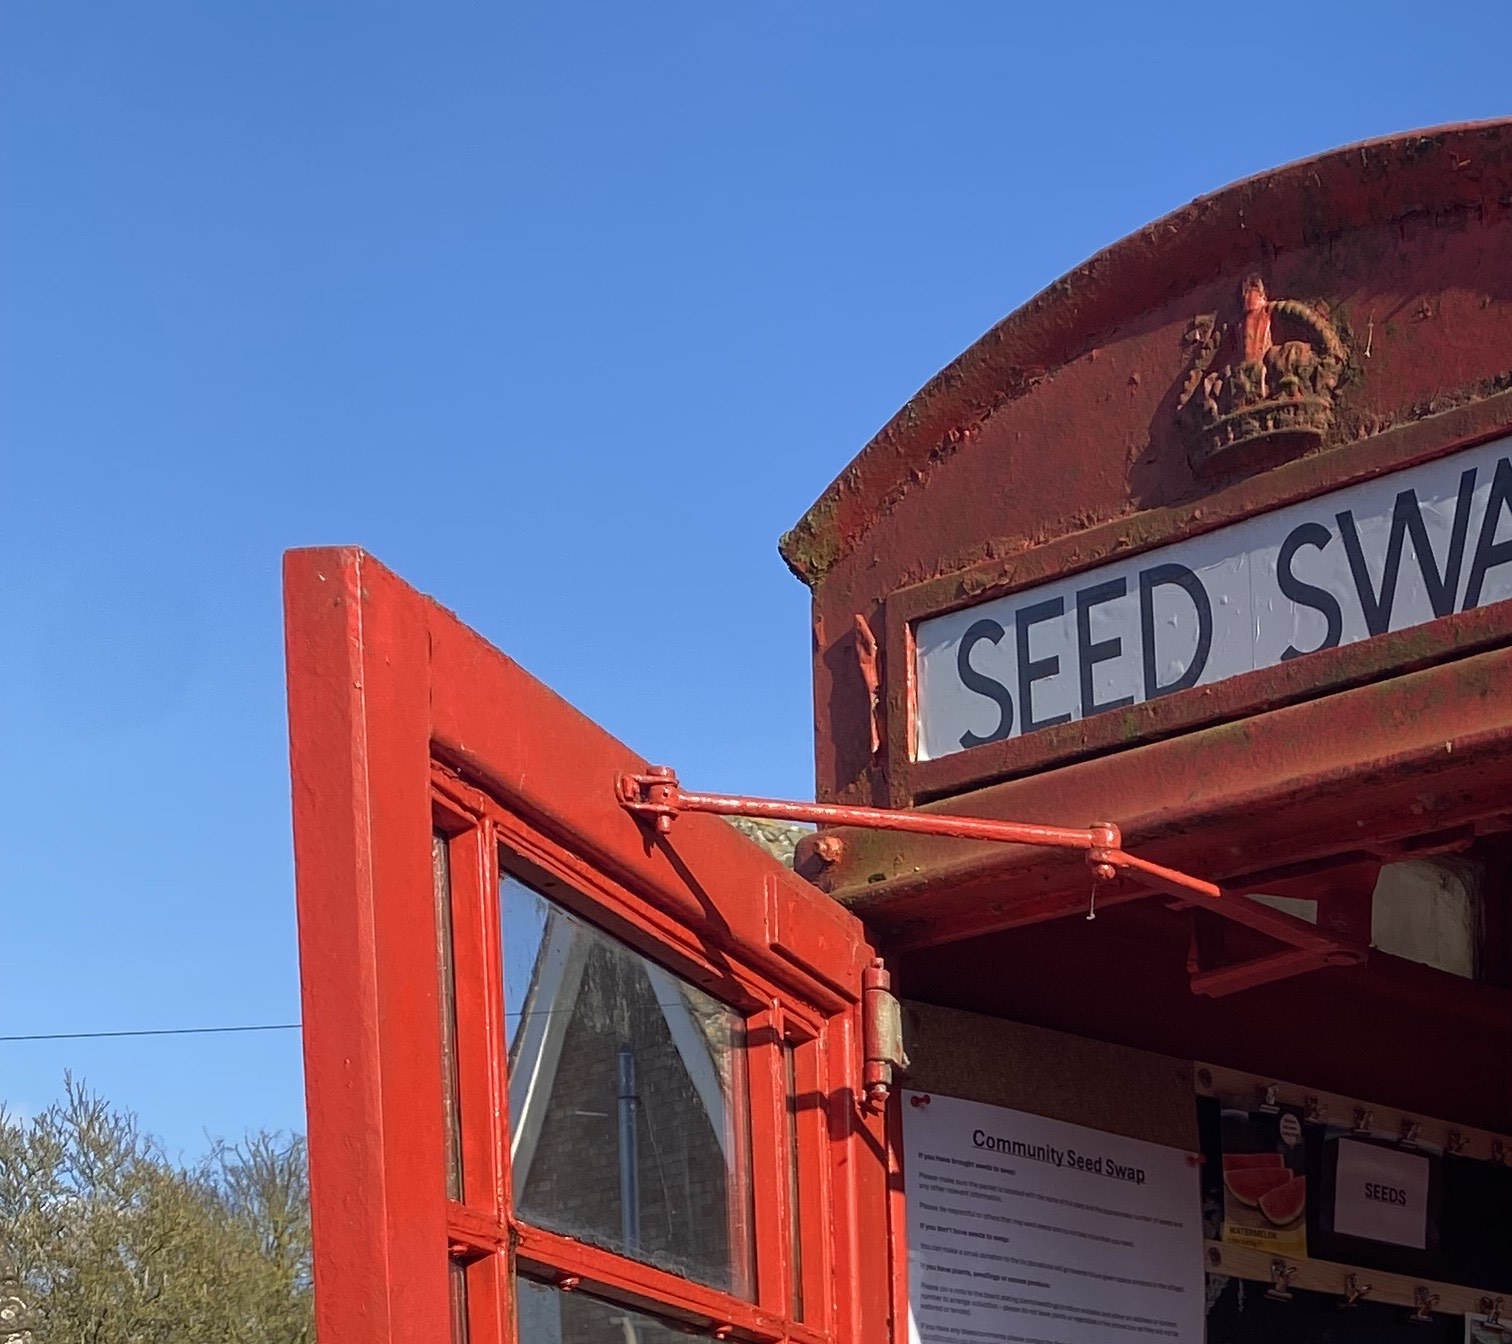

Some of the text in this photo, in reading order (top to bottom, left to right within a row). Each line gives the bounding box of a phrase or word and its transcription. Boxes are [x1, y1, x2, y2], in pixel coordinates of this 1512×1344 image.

[957, 561, 1214, 749] SEED
[972, 1129, 1146, 1186] Community Seed Swap
[1364, 1182, 1407, 1205] SEEDS
